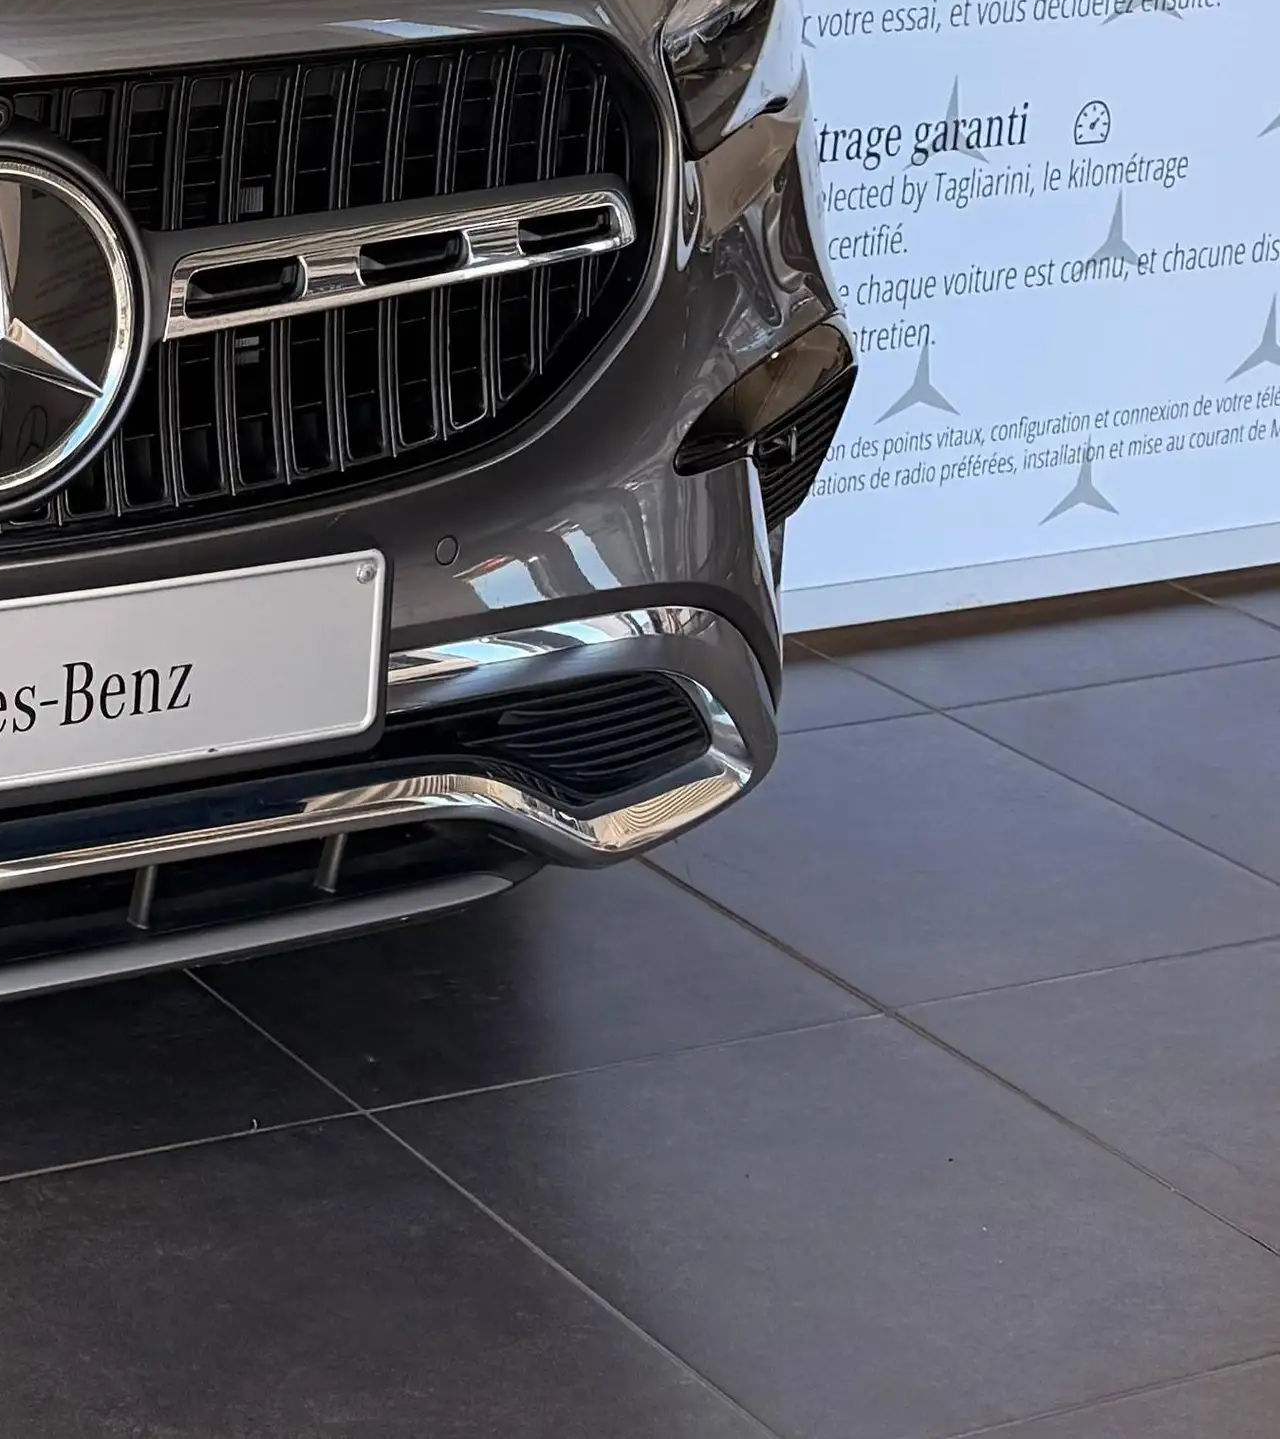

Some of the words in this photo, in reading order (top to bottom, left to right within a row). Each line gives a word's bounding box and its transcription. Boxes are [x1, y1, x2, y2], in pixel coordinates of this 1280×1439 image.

[818, 8, 874, 38] votre
[911, 101, 1028, 167] garanti
[901, 174, 928, 213] by
[935, 166, 1036, 209] Tagliarini,
[1042, 160, 1062, 192] le
[1067, 152, 1189, 191] kilométrage
[828, 222, 908, 261] certifié.
[856, 274, 937, 309] chaque
[943, 265, 1017, 295] voiture
[1023, 264, 1054, 287] est
[1059, 254, 1130, 285] connu,
[1136, 250, 1157, 276] et
[1162, 242, 1246, 273] chacune
[850, 436, 879, 460] des
[883, 431, 932, 461] points
[936, 425, 985, 449] vitaux,
[990, 411, 1091, 449] configuration
[1095, 410, 1109, 430] et
[1112, 400, 1189, 428] connexion
[1193, 394, 1212, 418] de
[1216, 390, 1253, 415] votre
[870, 467, 890, 489] de
[895, 462, 936, 487] radio
[940, 454, 1018, 487] préférées,
[1023, 443, 1105, 472] installation
[1110, 440, 1124, 461] et
[1127, 434, 1162, 456] mise
[1167, 433, 1185, 452] au
[1189, 422, 1244, 449] courant
[1248, 419, 1267, 441] de
